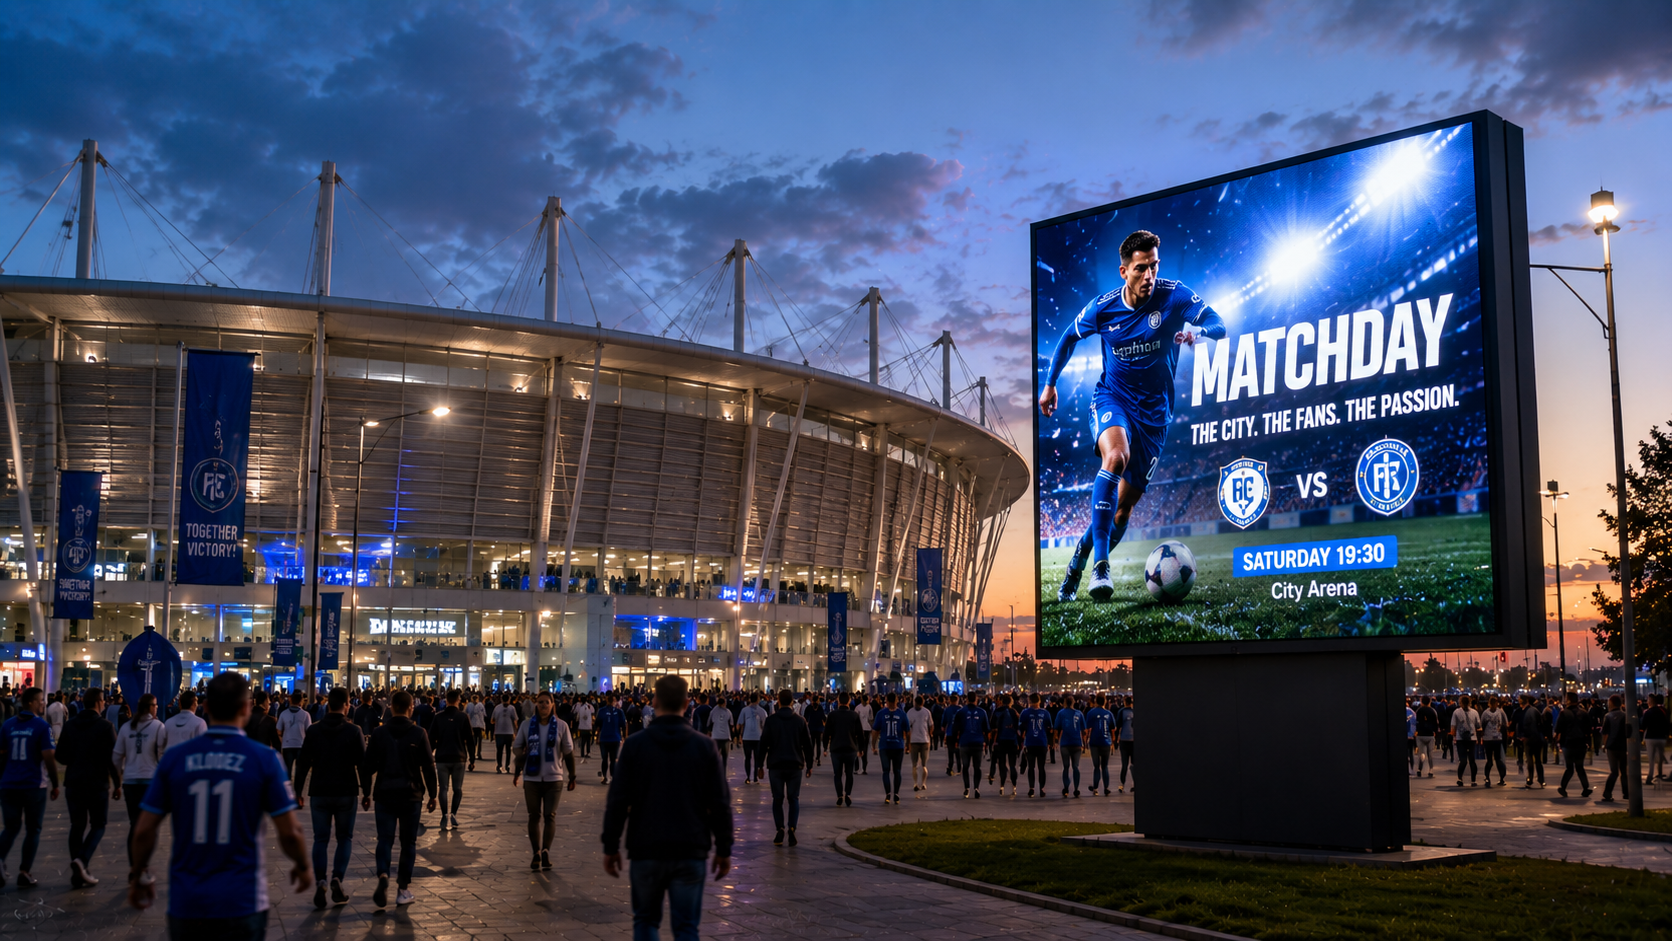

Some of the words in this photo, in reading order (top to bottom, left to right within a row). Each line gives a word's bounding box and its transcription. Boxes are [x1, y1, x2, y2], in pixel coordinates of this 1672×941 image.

[1191, 293, 1453, 407] MATCHDAY
[1191, 423, 1218, 445] THE
[1222, 415, 1258, 442] CITY.
[1263, 410, 1292, 435] THE
[1295, 403, 1340, 430] FANS.
[1345, 396, 1376, 422] THE
[1381, 384, 1460, 417] PASSION.
[1296, 471, 1328, 499] VS
[186, 523, 238, 541] TOGETHER
[187, 541, 237, 558] VICTORY!
[1243, 547, 1331, 571] SATURDAY
[1336, 543, 1385, 566] 19:30
[1271, 582, 1304, 602] City
[1307, 580, 1358, 598] Arena
[12, 737, 27, 760] 11
[188, 779, 234, 844] 11
